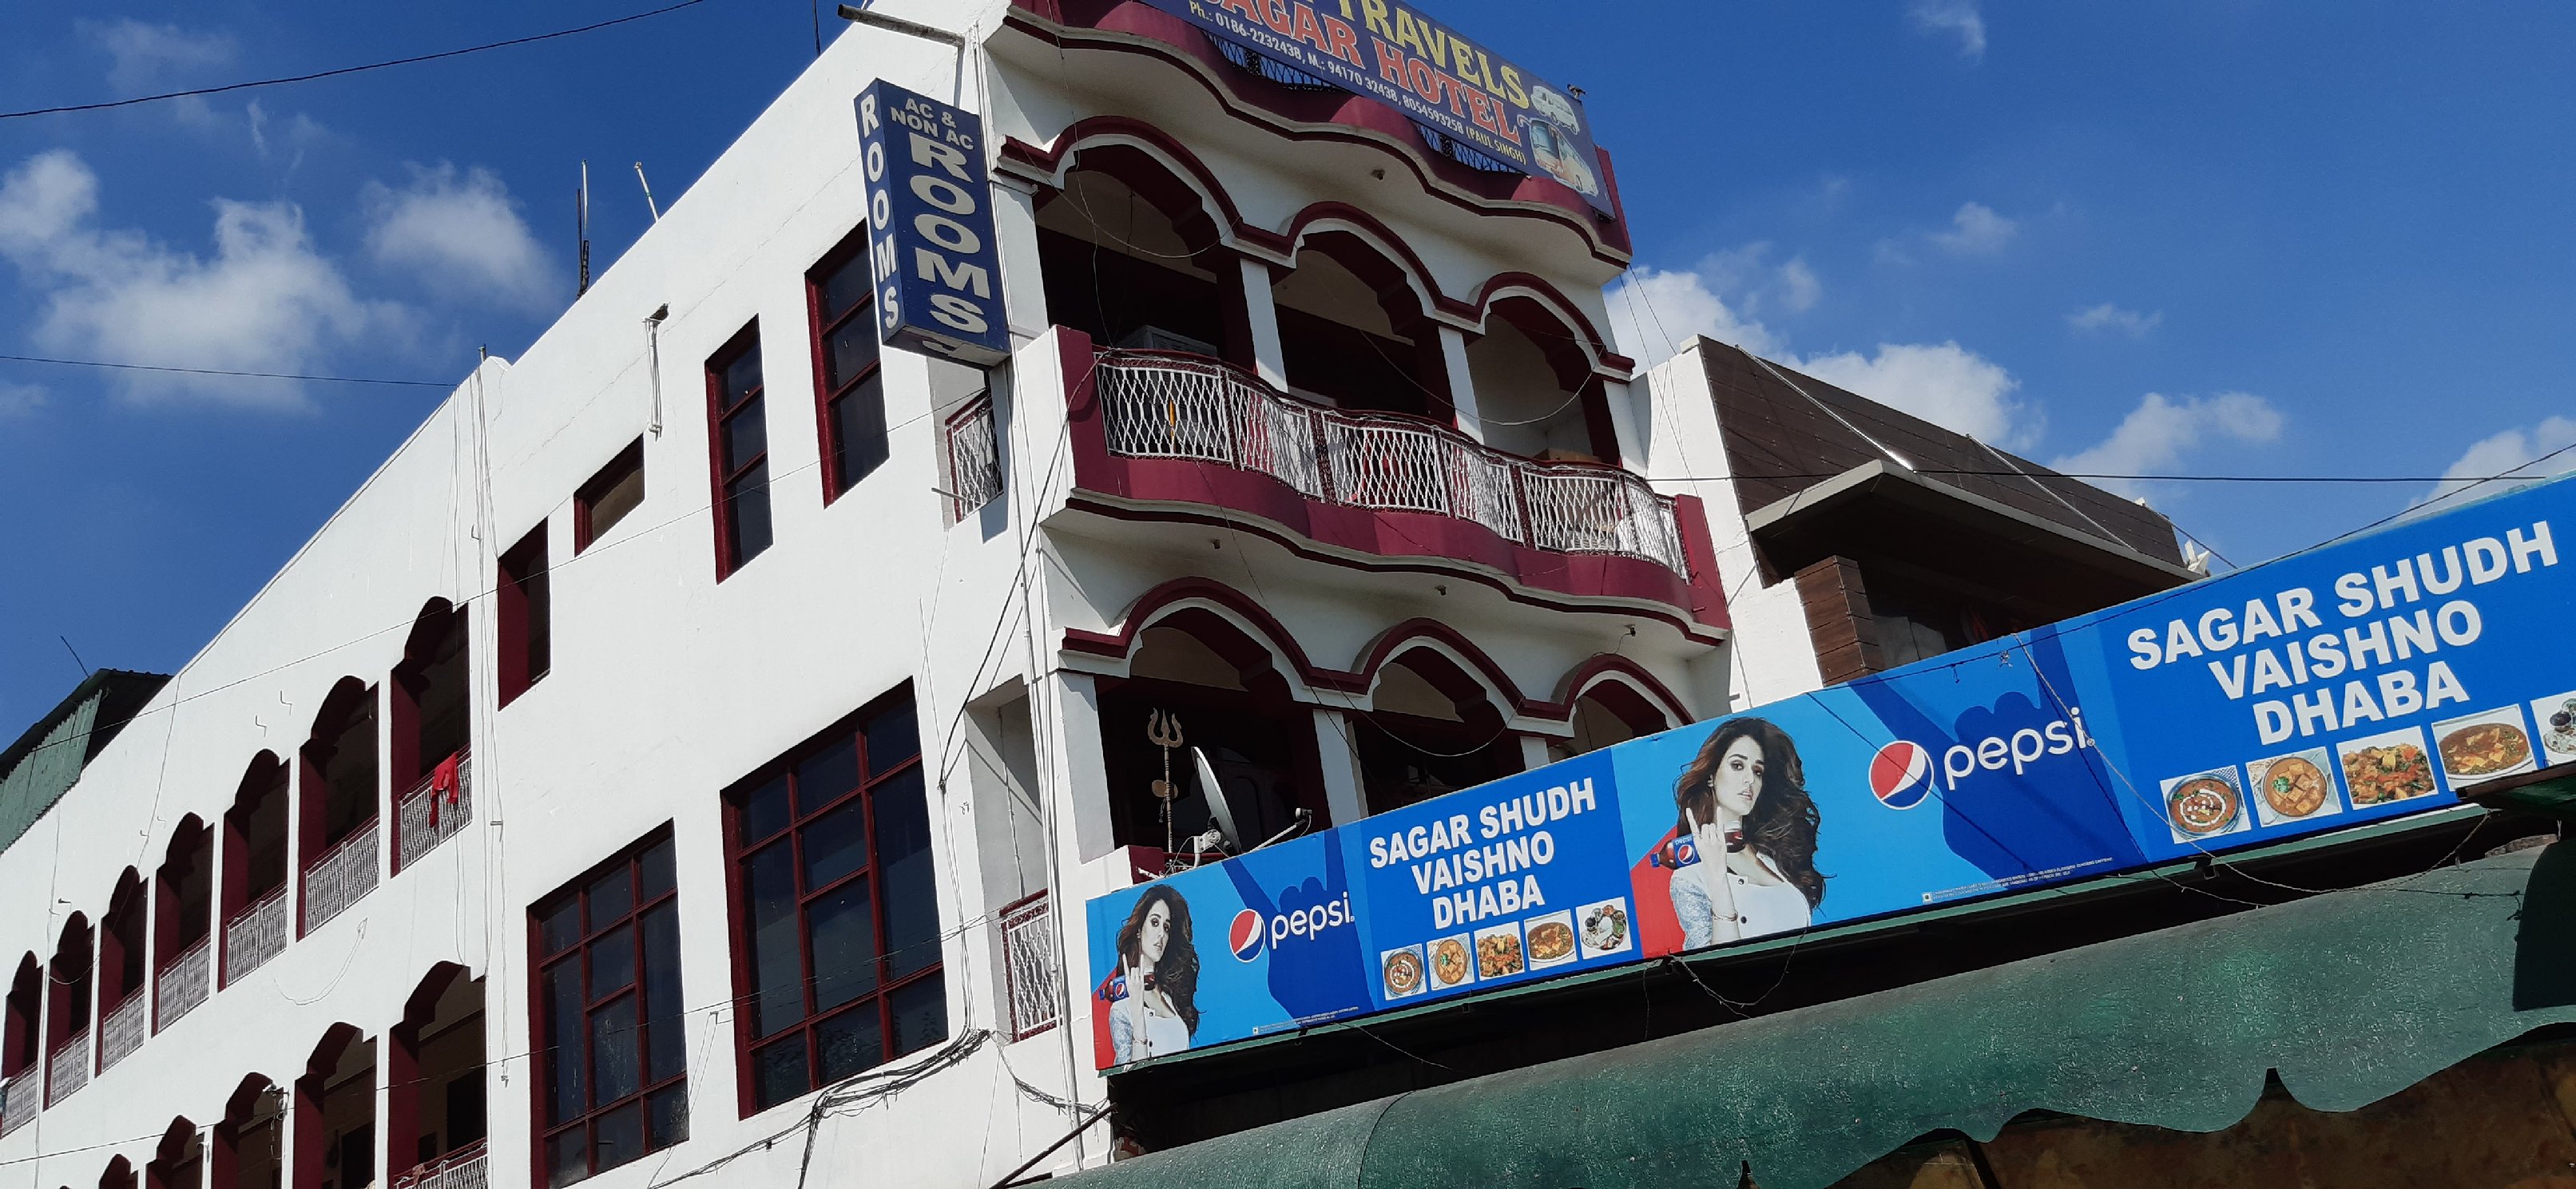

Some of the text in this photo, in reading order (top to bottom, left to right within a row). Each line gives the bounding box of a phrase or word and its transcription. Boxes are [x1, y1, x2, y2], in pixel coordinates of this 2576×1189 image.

[905, 98, 957, 129] AC &
[1205, 0, 1522, 147] GAR HOTEL
[1328, 61, 1363, 85] 94170
[1465, 126, 1494, 149] (PAUL
[1494, 139, 1526, 164] SINGH)
[891, 106, 974, 150] NON AC
[860, 93, 899, 329] ROOMS
[909, 132, 990, 334] ROOMS
[2127, 521, 2558, 671] SAGAR SHUDH
[2208, 600, 2483, 700] VAISHNO
[2252, 660, 2470, 746] DHABA
[1943, 707, 2087, 791] pepsi
[1369, 777, 1596, 868] SAGAR SHUDH
[1411, 830, 1554, 894] VAISHNO
[1272, 891, 1350, 949] pepsi
[1432, 874, 1546, 929] DHABA
